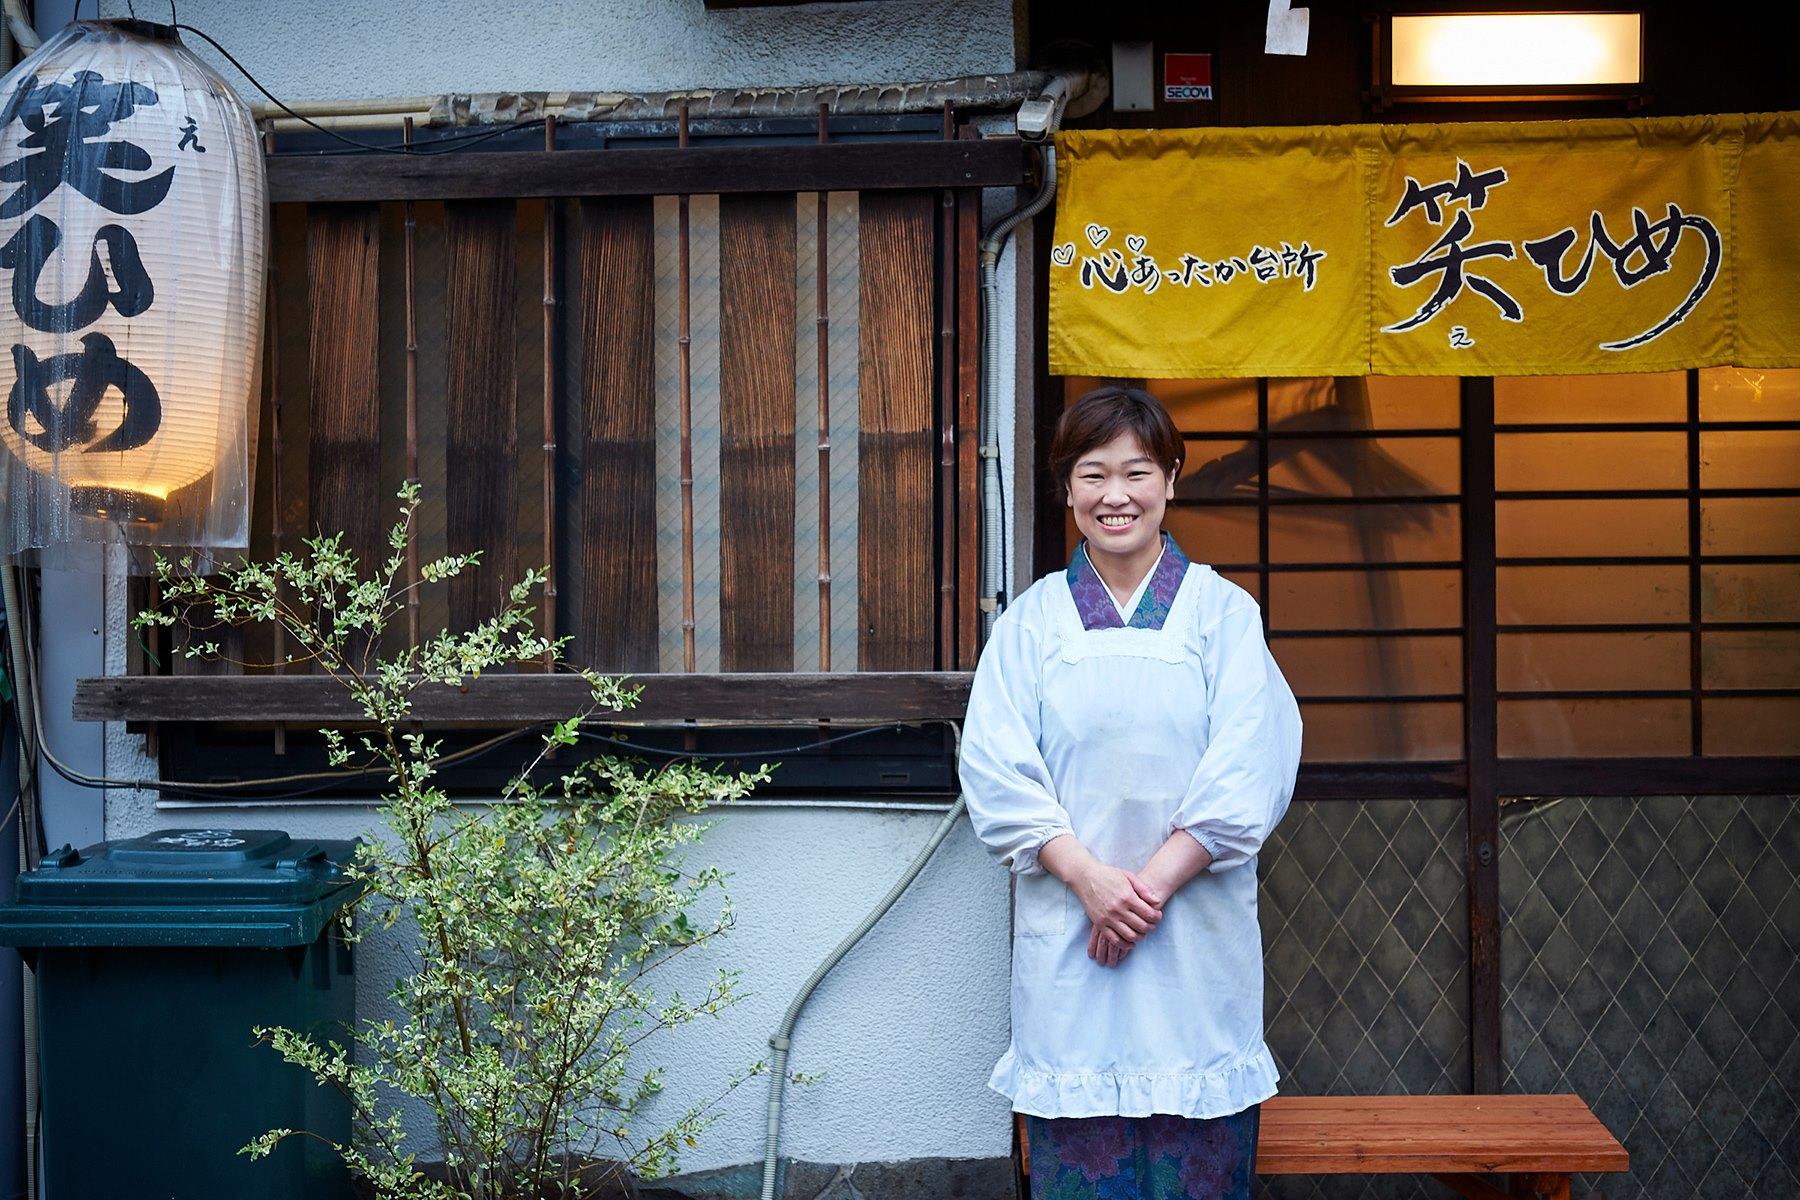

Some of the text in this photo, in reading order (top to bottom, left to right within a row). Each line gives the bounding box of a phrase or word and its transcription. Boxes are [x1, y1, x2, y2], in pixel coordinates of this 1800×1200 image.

[1168, 86, 1209, 98] SECOM
[178, 116, 206, 153] え
[1081, 242, 1326, 292] 心あったか台所
[1381, 159, 1722, 350] 笑ひめ
[1450, 327, 1473, 347] え
